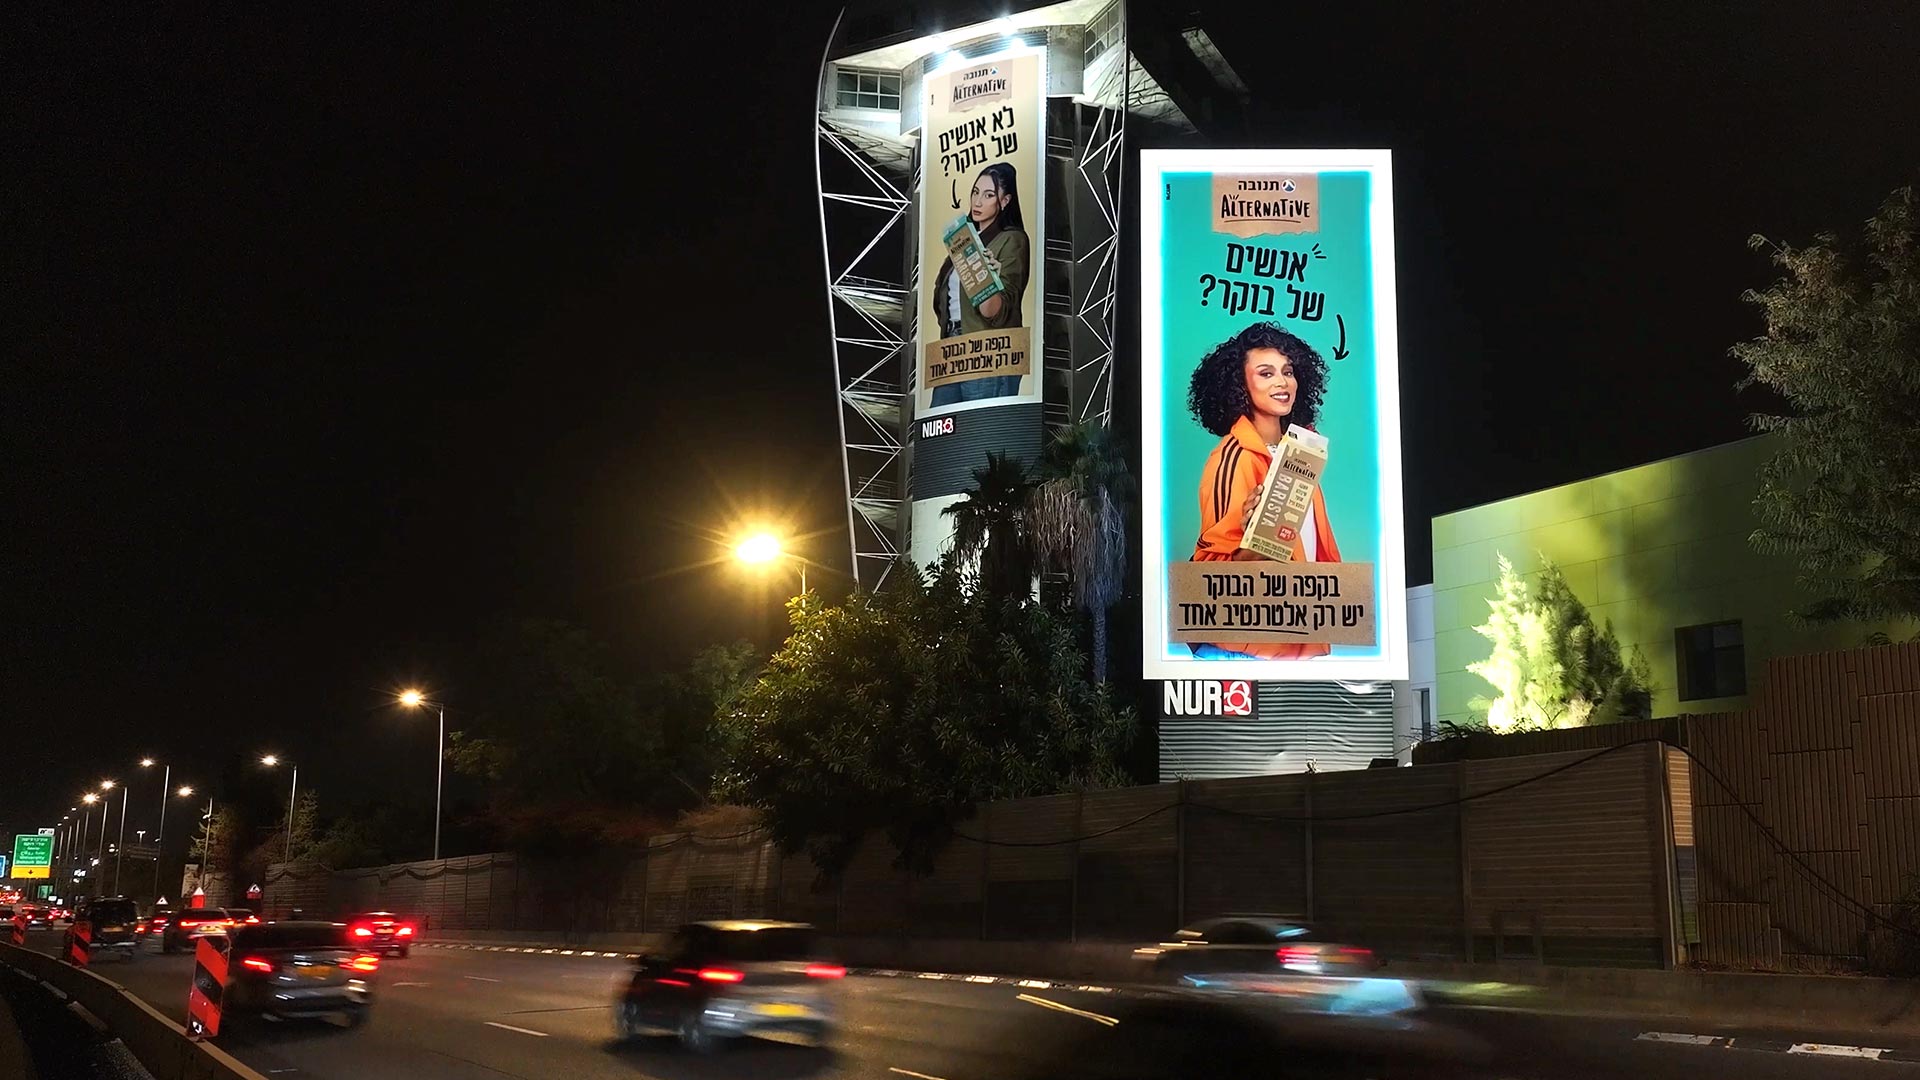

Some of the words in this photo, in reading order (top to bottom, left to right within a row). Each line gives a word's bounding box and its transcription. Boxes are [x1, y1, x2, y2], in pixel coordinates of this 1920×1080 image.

[963, 69, 989, 81] תנובה
[992, 106, 1015, 132] לא
[938, 116, 987, 153] אנשים
[991, 132, 1018, 158] של
[940, 143, 988, 177] בוקר?
[1238, 180, 1279, 191] תנובה
[1225, 243, 1308, 282] אנשים
[1200, 274, 1275, 316] בוקר?
[1286, 283, 1325, 321] של
[941, 343, 966, 360] הבוקר
[969, 339, 983, 354] של
[985, 336, 1011, 352] בקפה
[930, 362, 947, 378] אחד
[949, 353, 993, 374] אלטרנטיב
[995, 353, 1008, 369] רק
[1011, 352, 1024, 365] יש
[922, 419, 943, 438] NUR
[1261, 473, 1293, 528] BARISTA
[1202, 574, 1254, 601] הבוקר
[1260, 572, 1286, 597] של
[1292, 574, 1341, 601] בקפה
[1179, 603, 1217, 627] אחד
[1222, 601, 1307, 627] אלטרנטיב
[1313, 604, 1335, 631] רק
[1342, 604, 1364, 627] יש
[1163, 680, 1223, 716] NUR
